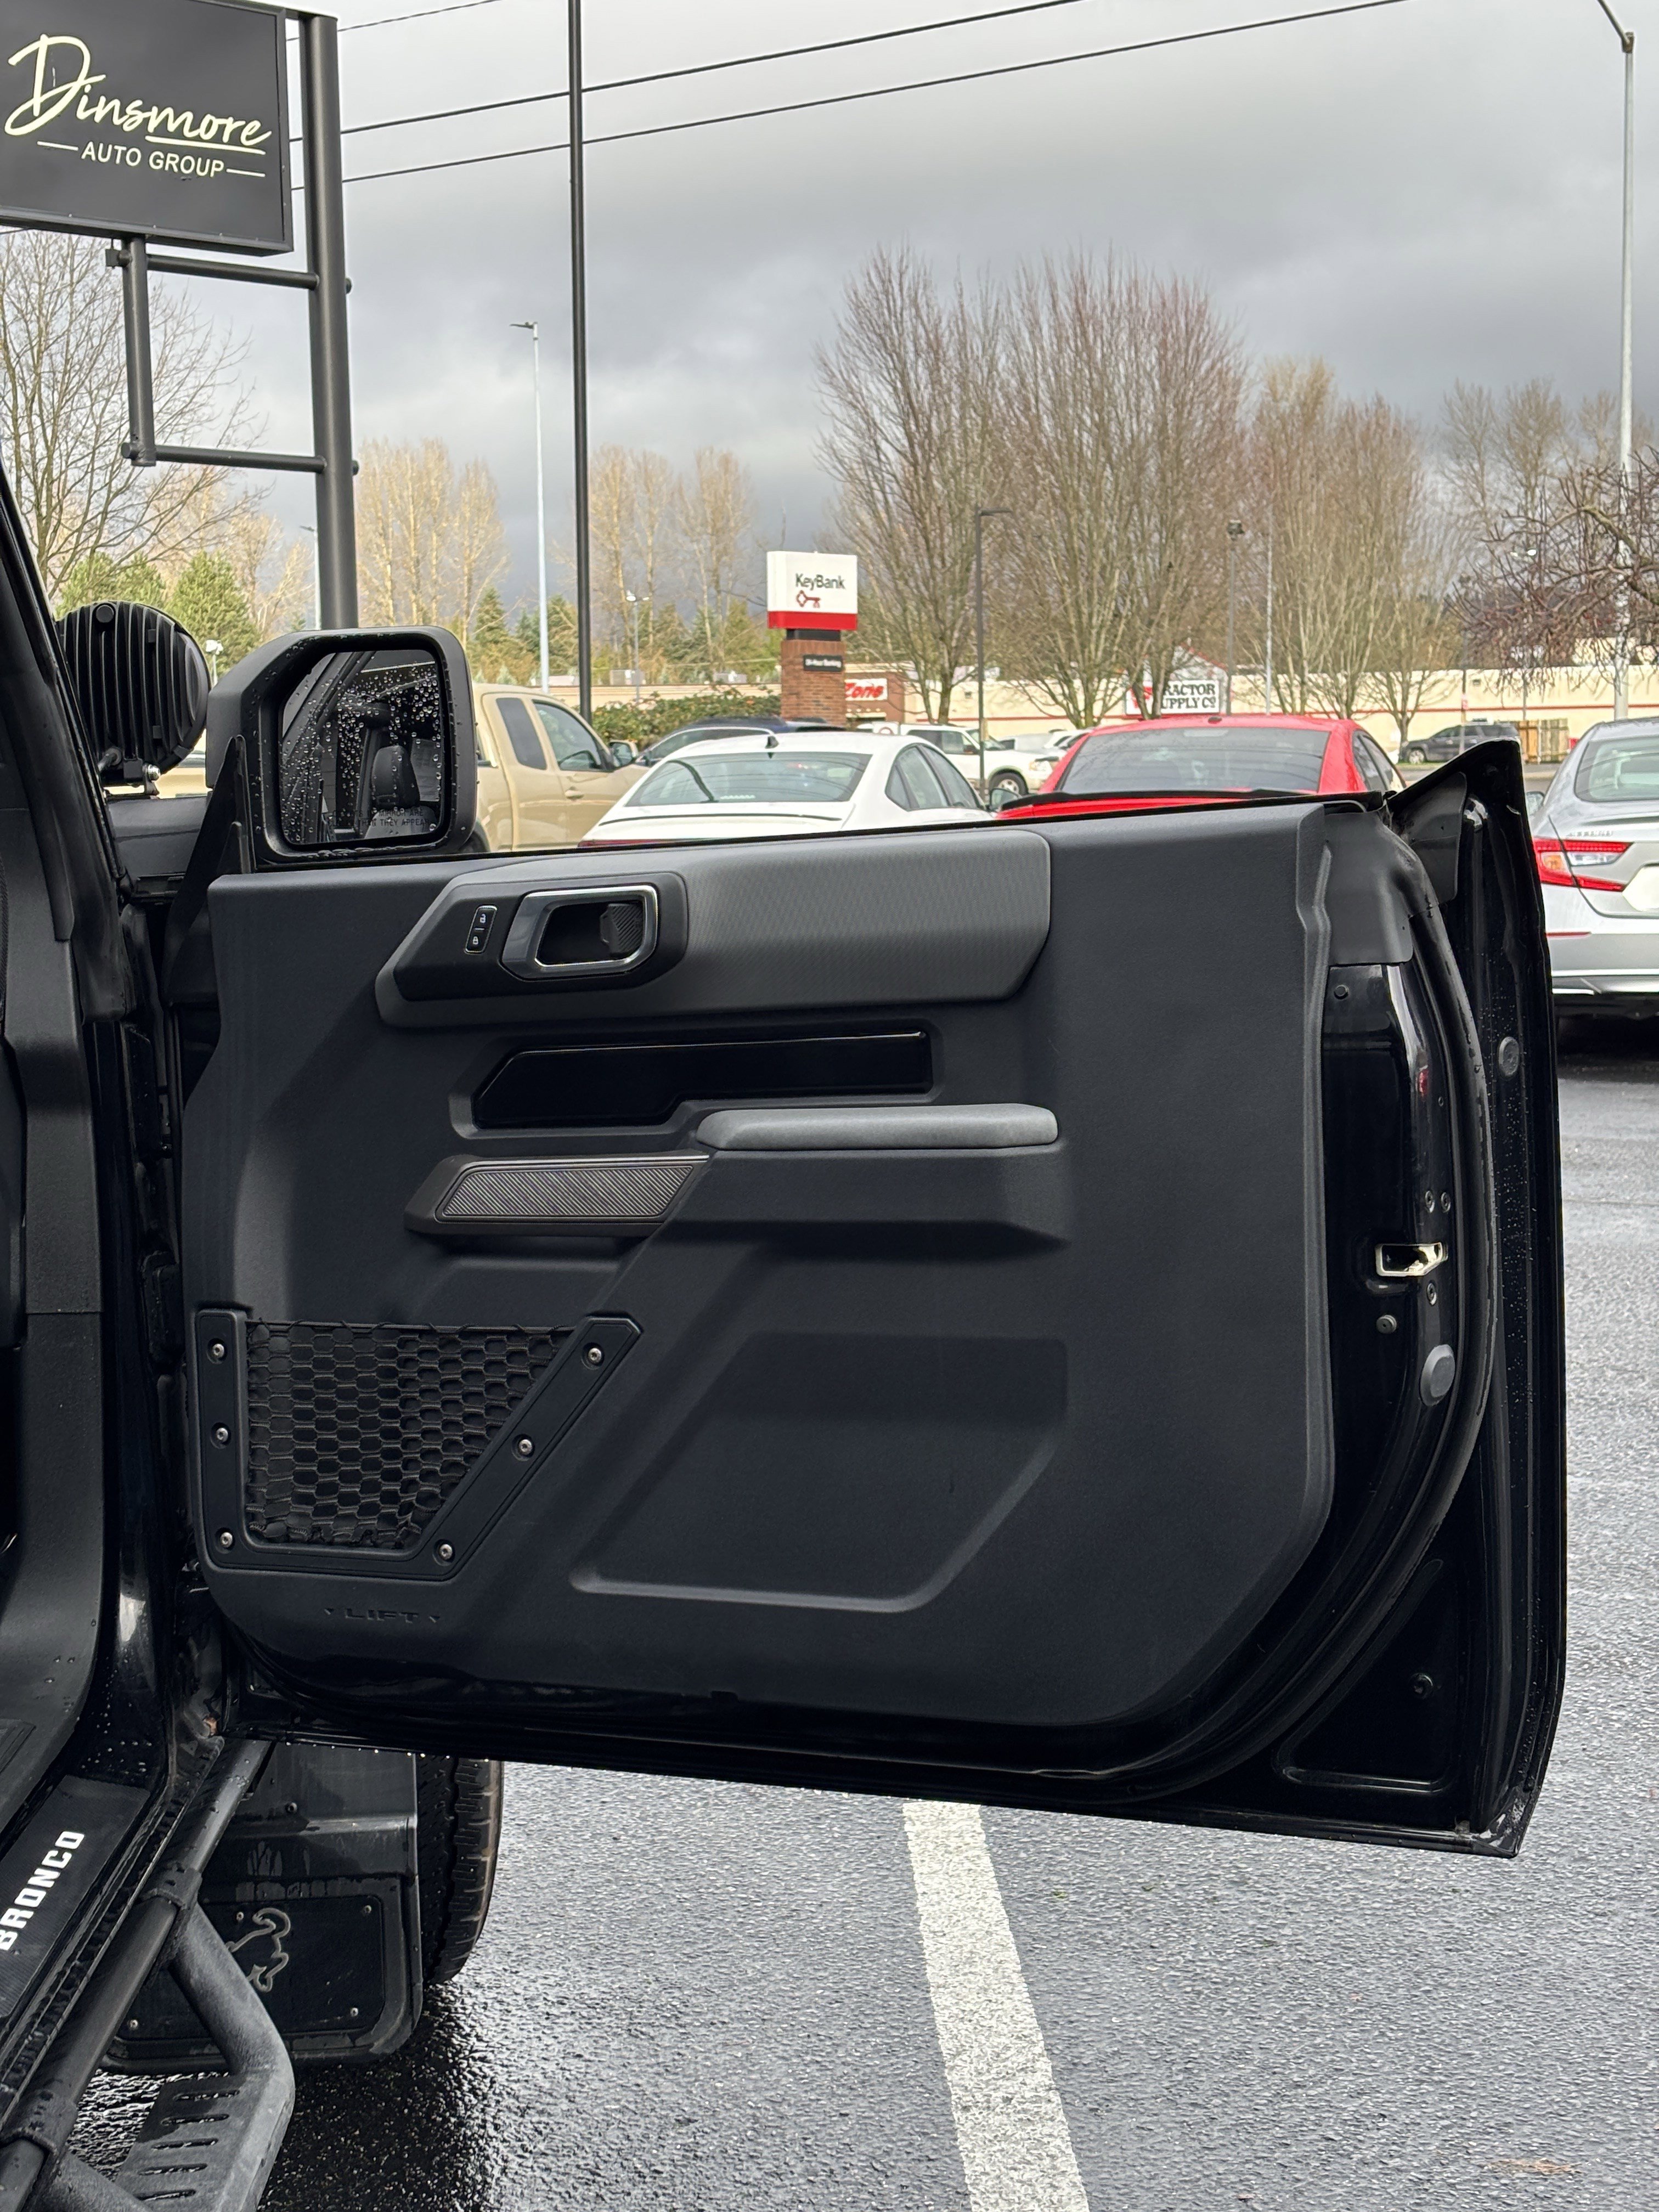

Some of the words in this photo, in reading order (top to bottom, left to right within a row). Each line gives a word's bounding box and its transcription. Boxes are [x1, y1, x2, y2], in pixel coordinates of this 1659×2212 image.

[4, 33, 272, 146] Dinsmore
[81, 141, 142, 167] AUTO
[148, 150, 225, 178] GROUP
[795, 573, 846, 591] KeyBank
[1162, 684, 1216, 696] RACTOR
[1160, 696, 1199, 709] UPPLY
[345, 1607, 419, 1624] LIFT
[0, 1831, 85, 1951] BRONCO
